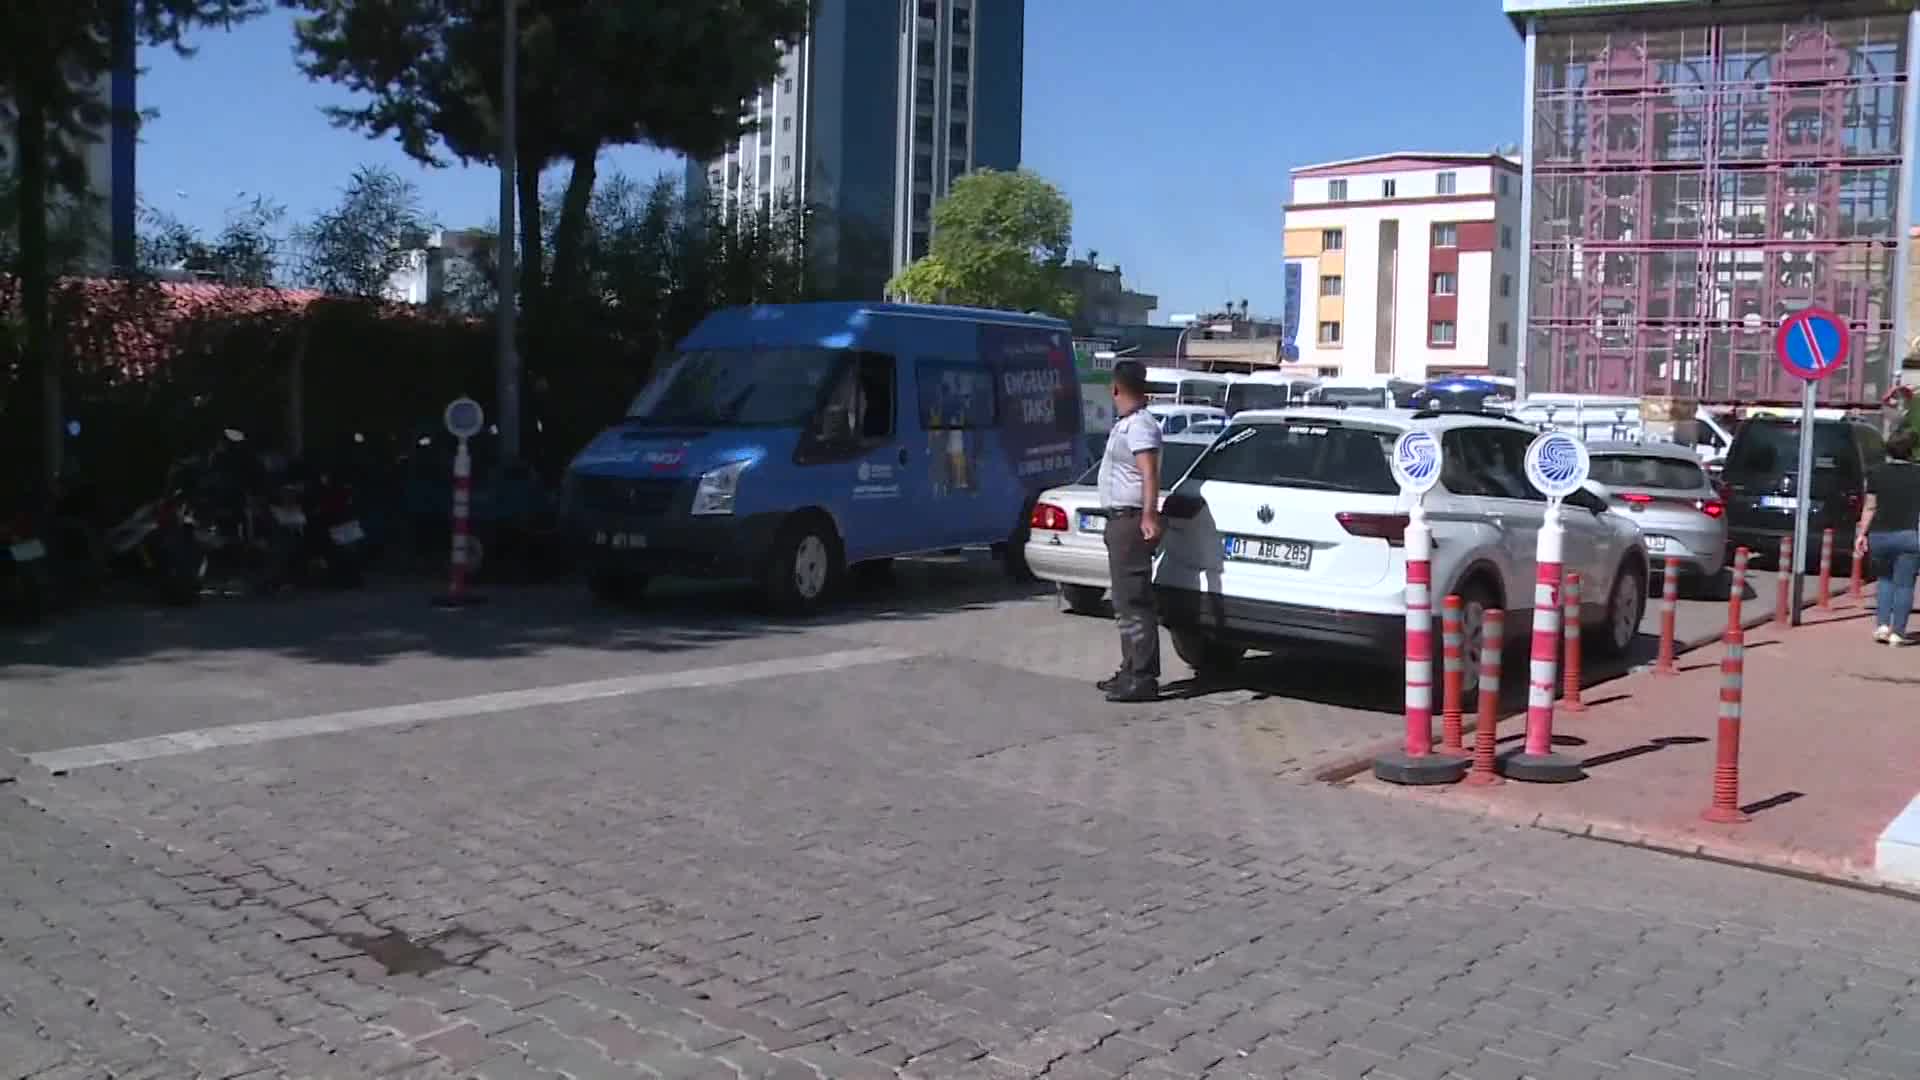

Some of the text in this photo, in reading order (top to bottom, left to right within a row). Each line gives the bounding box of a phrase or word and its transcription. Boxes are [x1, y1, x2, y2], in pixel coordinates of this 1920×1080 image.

[1233, 539, 1307, 562] 01 ABC 285
